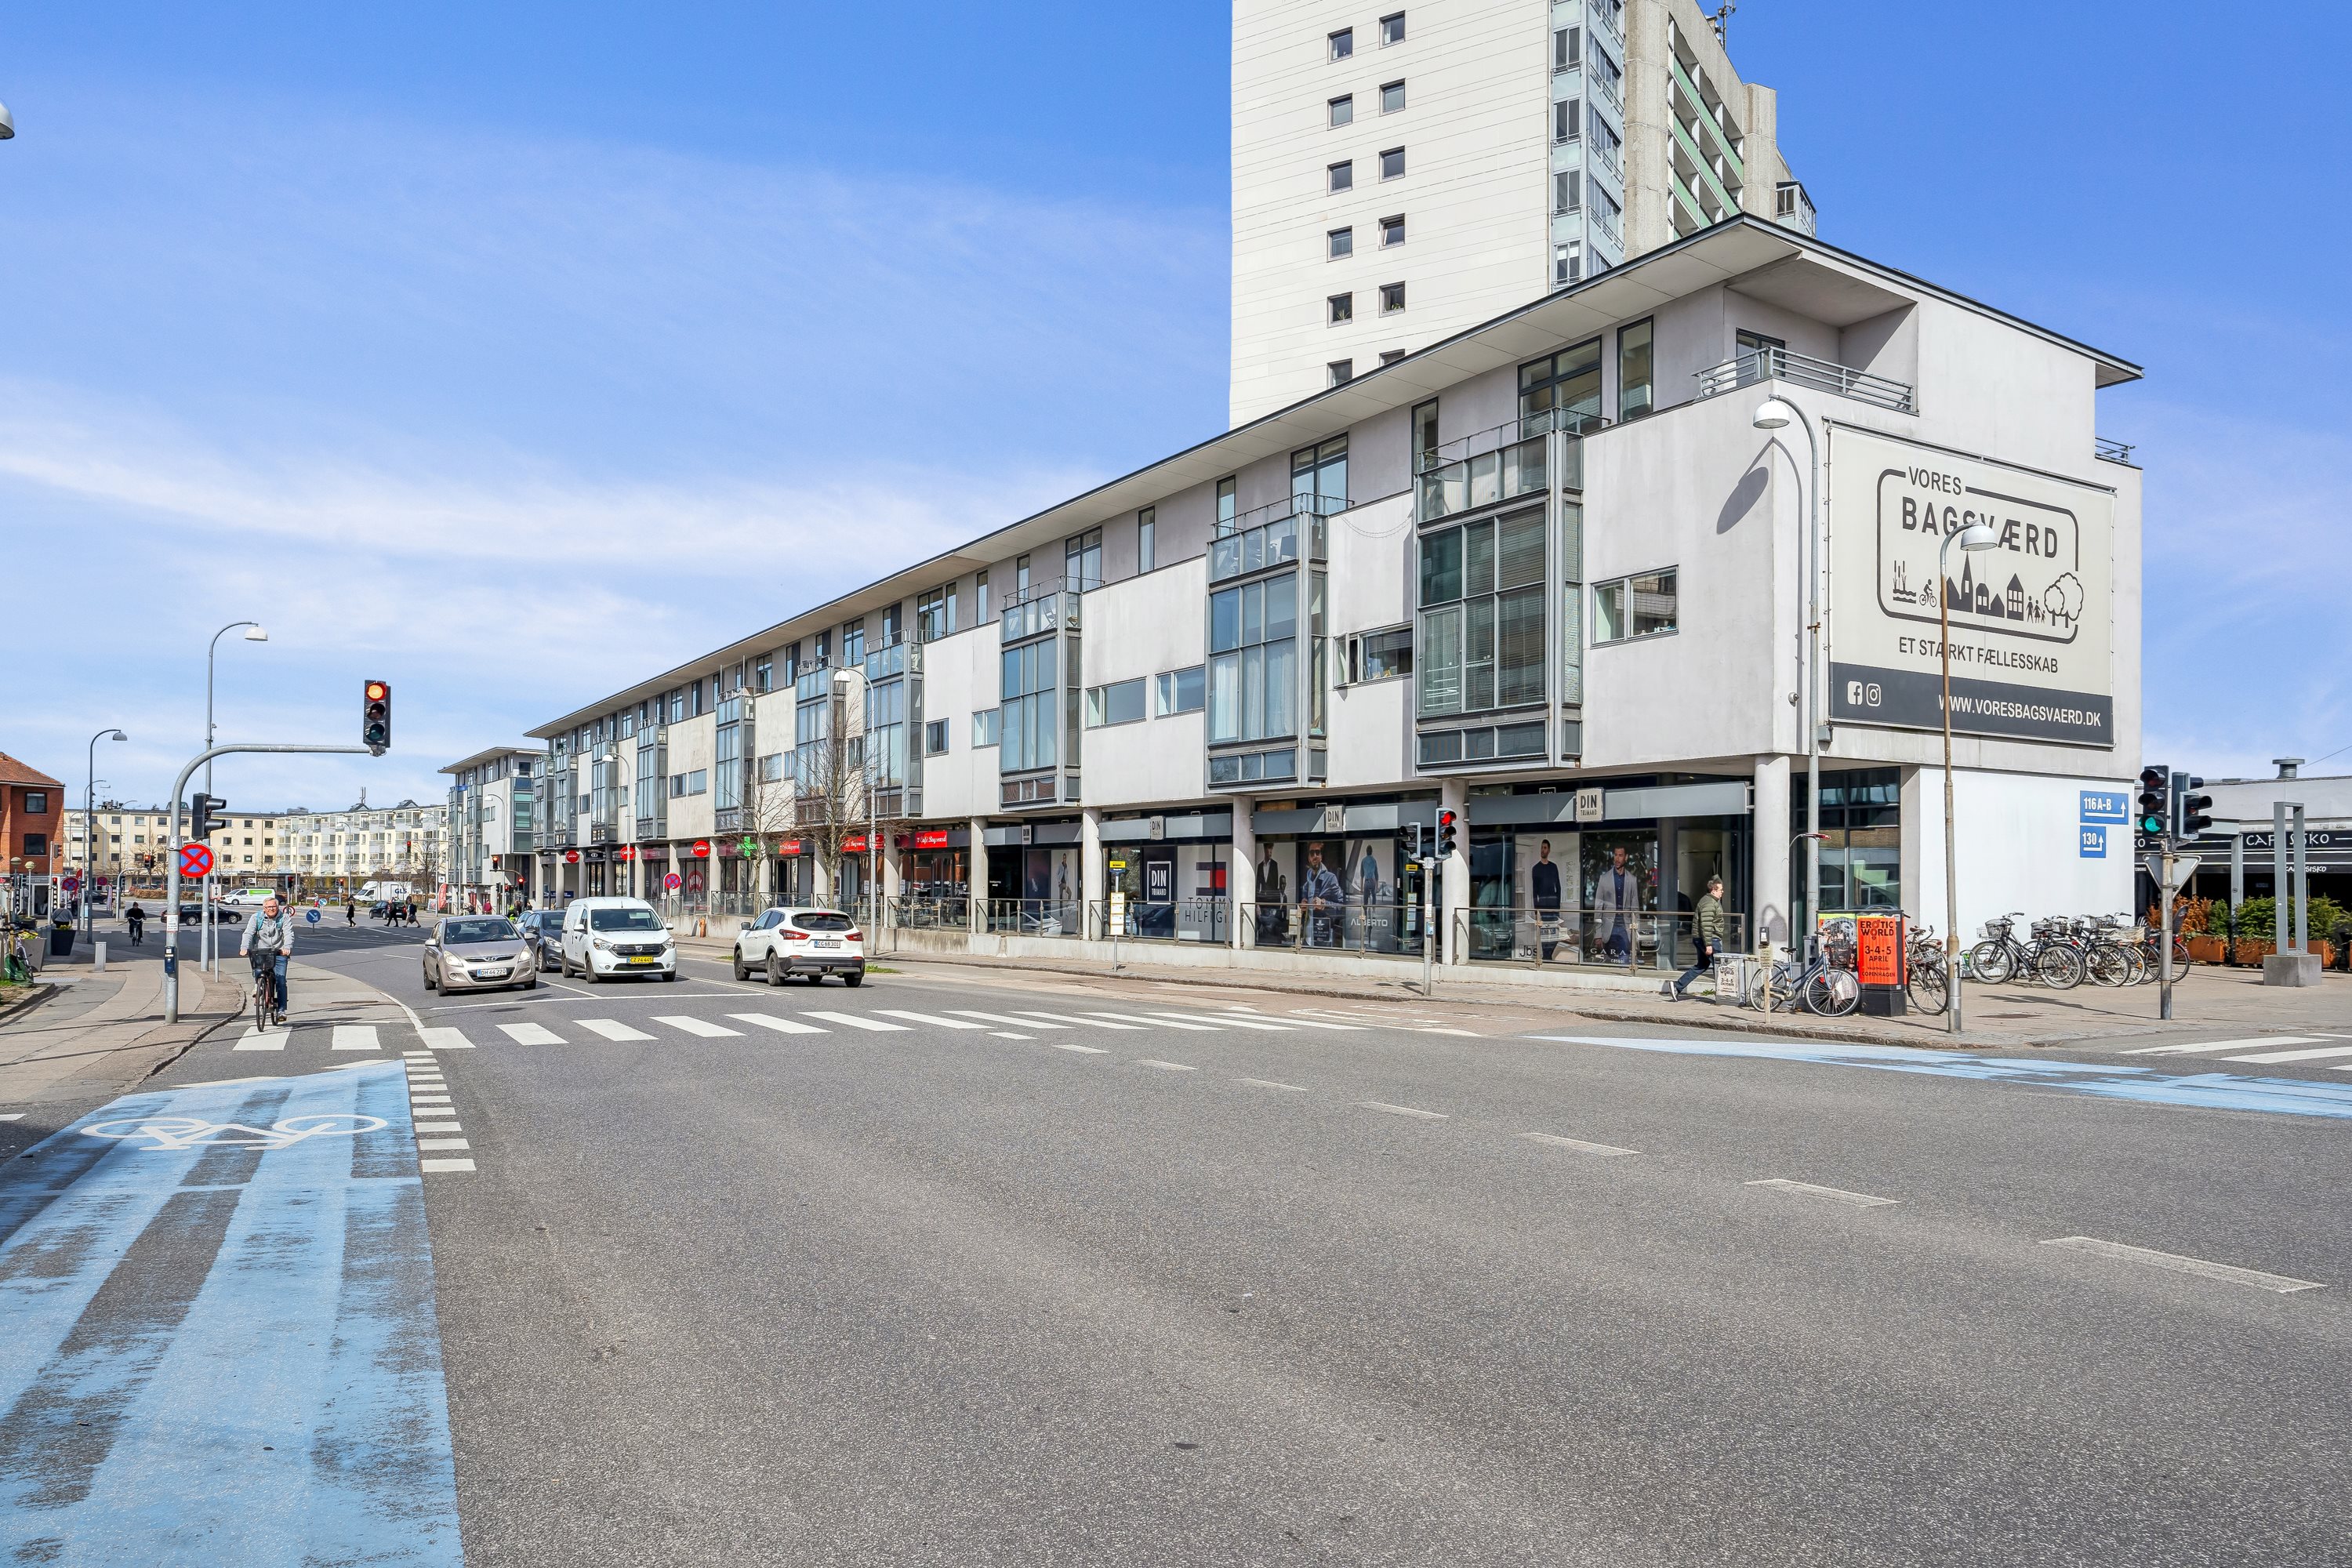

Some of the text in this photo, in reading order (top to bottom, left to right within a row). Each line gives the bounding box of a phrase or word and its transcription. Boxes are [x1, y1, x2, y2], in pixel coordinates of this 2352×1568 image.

[1908, 466, 1962, 495] VORES
[1899, 636, 1916, 655] ET
[1977, 648, 2059, 673] FÆLLESSKAB
[1580, 794, 1598, 809] DIN
[1327, 810, 1339, 822] DIN
[1152, 821, 1161, 831] DIN
[2082, 832, 2097, 846] 130
[1151, 869, 1167, 887] DIN
[1188, 897, 1233, 910] TOMMY
[1185, 909, 1233, 924] HILFIG
[1861, 928, 1894, 938] WORLD
